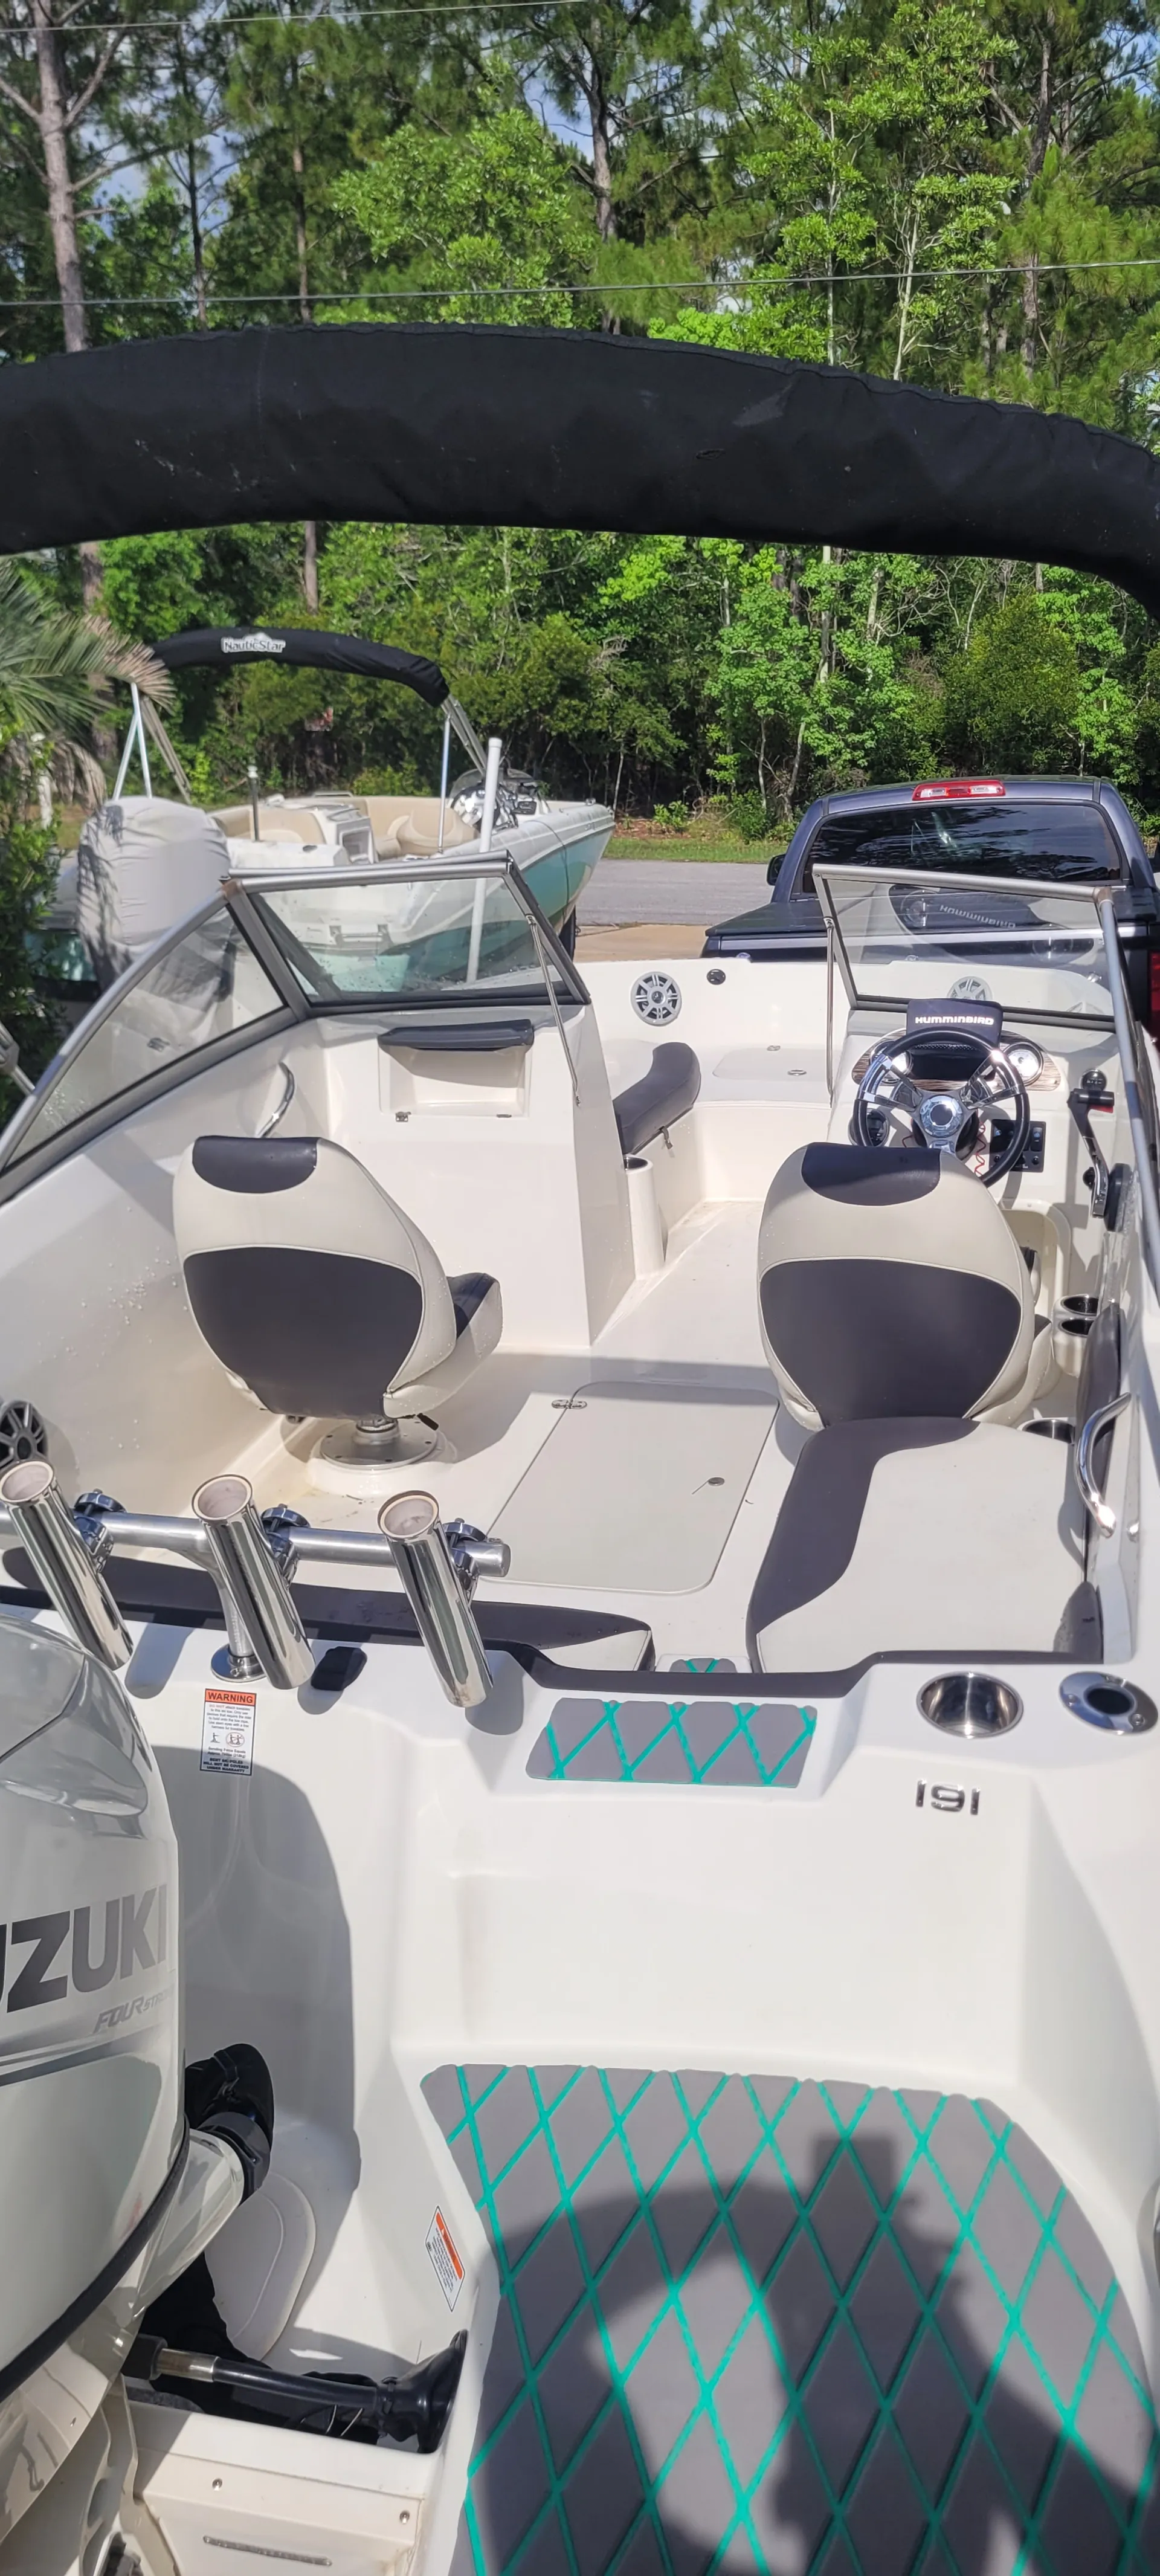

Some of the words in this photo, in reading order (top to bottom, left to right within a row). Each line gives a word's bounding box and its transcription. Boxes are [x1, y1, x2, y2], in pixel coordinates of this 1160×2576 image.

[224, 639, 283, 651] NauticStar
[915, 1016, 994, 1025] HUMMINBIRD
[208, 1692, 253, 1703] WARNING
[915, 1780, 980, 1815] 191
[0, 1884, 167, 2013] ZUKI
[93, 1995, 144, 2034] FOUR
